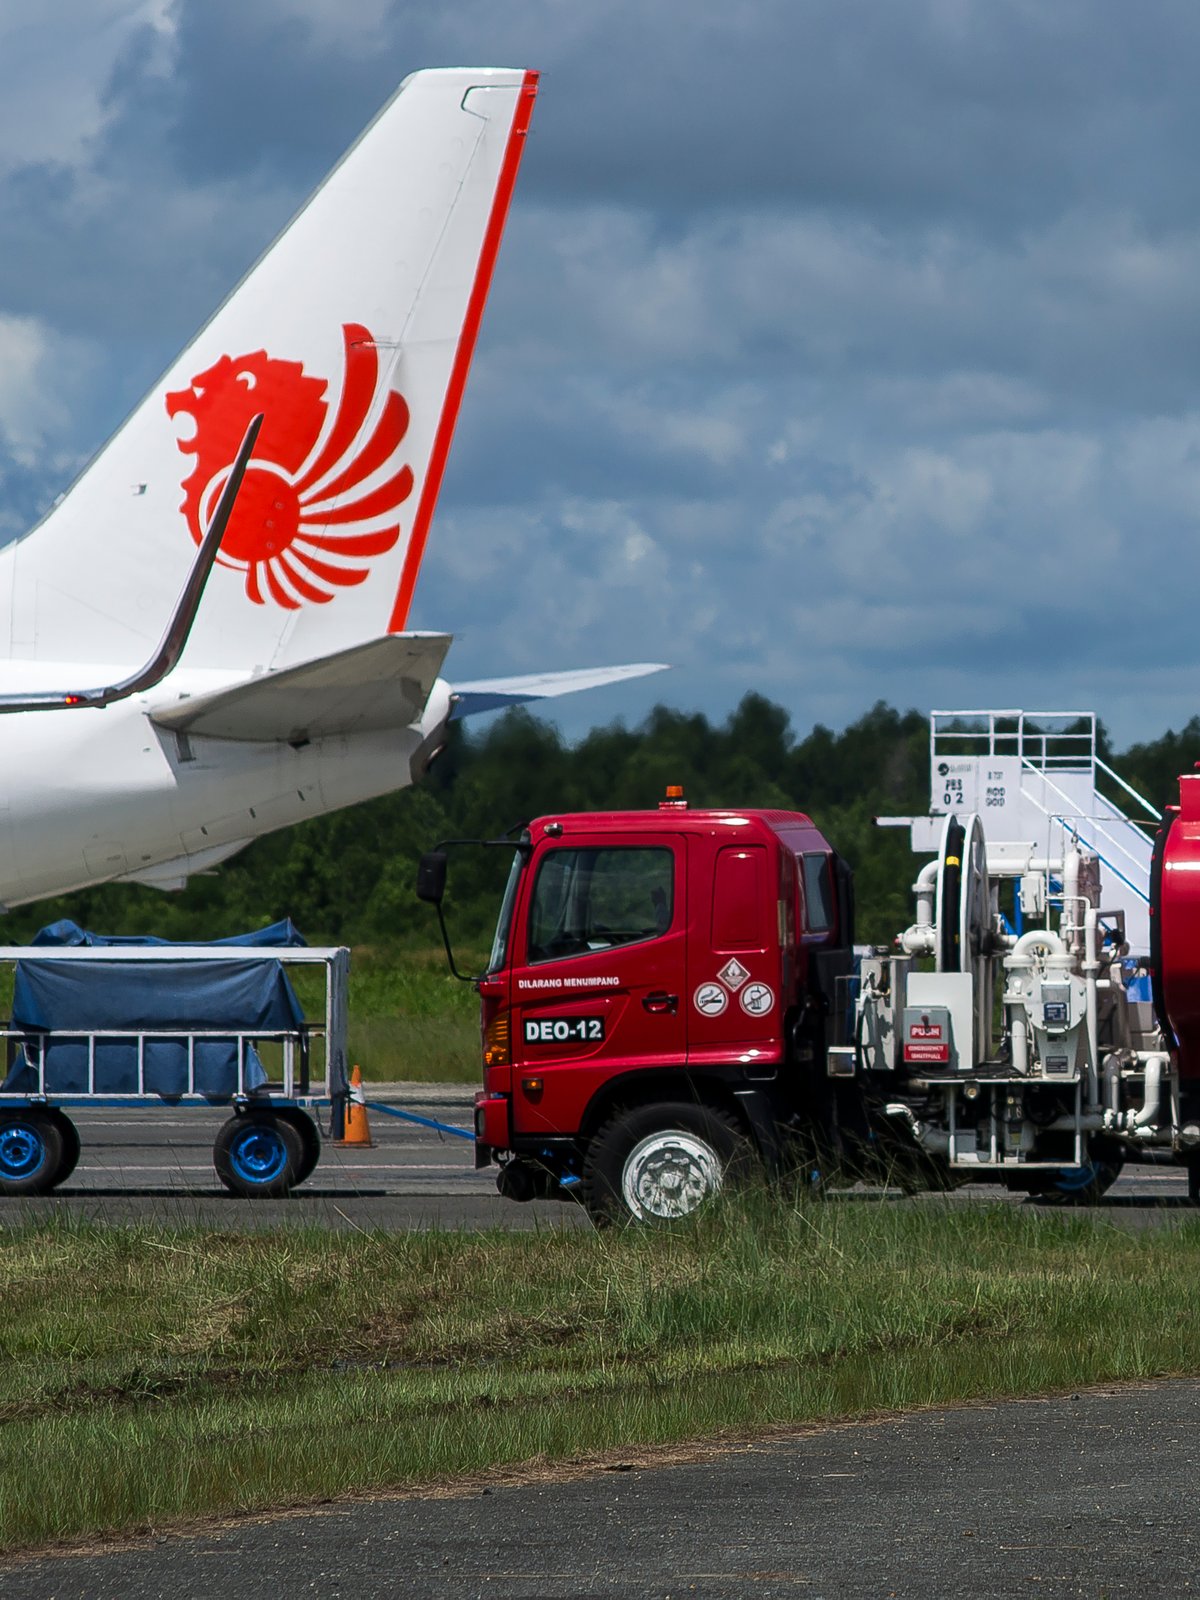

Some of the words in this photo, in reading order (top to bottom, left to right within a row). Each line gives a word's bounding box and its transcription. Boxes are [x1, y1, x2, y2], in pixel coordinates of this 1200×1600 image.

[518, 978, 562, 989] DILARANG
[563, 976, 620, 988] MENUMPANG
[525, 1020, 602, 1041] DEO-12
